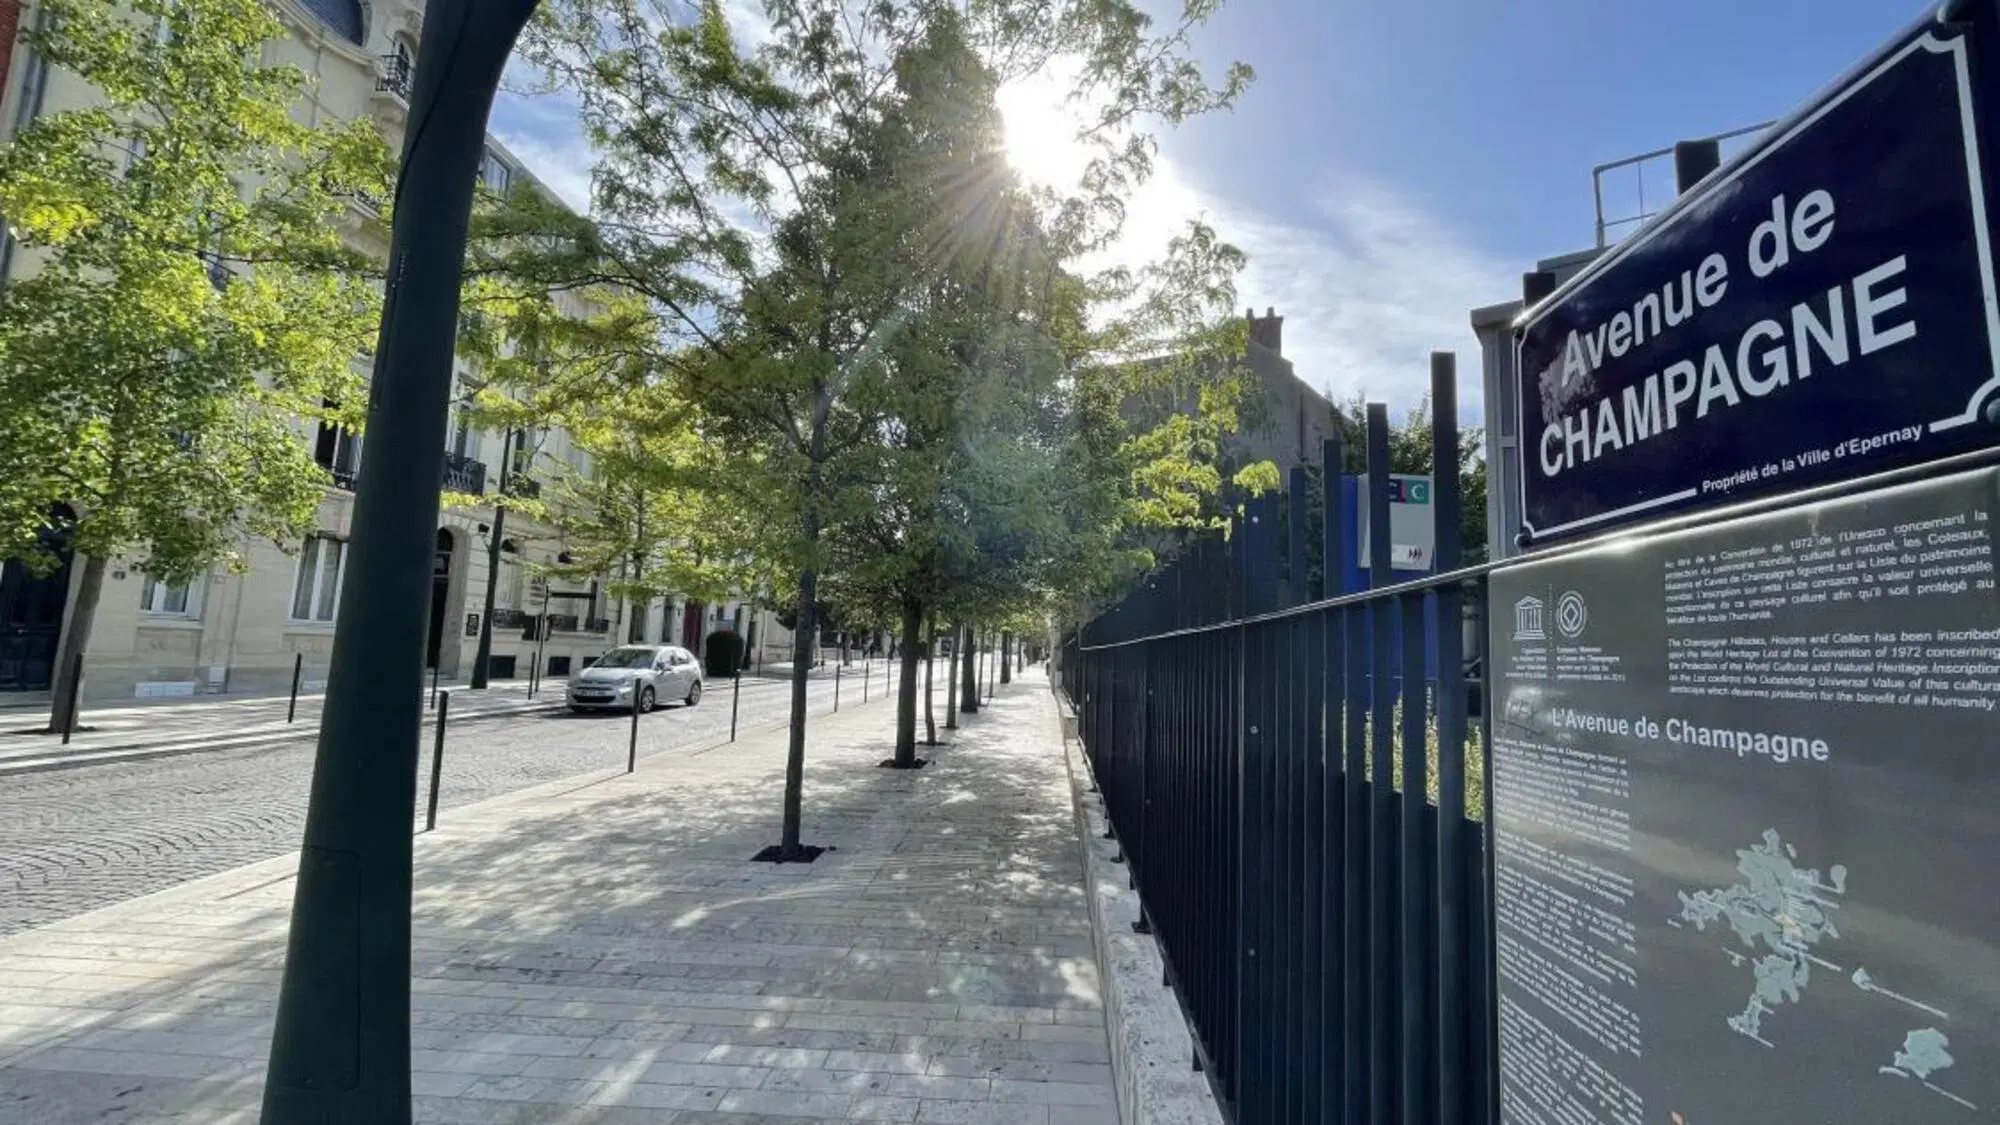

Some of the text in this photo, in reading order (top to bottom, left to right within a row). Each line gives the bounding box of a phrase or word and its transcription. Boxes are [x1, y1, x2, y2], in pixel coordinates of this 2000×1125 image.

[1562, 188, 1836, 387] Avenue de
[1540, 254, 1917, 477] CHAMPAGNE
[1702, 424, 1922, 493] Propriété de la Ville d'Epernay
[1894, 513, 1965, 534] concernant
[1974, 509, 1988, 521] la
[1903, 537, 1922, 548] les
[1869, 556, 1897, 567] Liste
[1899, 553, 1917, 564] du
[1920, 544, 1992, 564] patrimoine
[1878, 570, 1914, 581] valeur
[1920, 560, 1993, 577] universelle
[1917, 579, 1967, 596] protégé
[1976, 578, 1995, 589] au
[1874, 631, 1897, 643] has
[1901, 630, 1932, 642] been
[1875, 646, 1887, 658] of
[1891, 646, 1921, 658] 1972
[1926, 645, 2000, 660] concerning
[1872, 677, 1905, 689] Value
[1908, 677, 1922, 689] of
[1925, 678, 1949, 690] this
[1953, 679, 2000, 692] cultura
[1836, 691, 1853, 702] the
[1856, 691, 1895, 704] benefit
[1897, 692, 1911, 705] of
[1913, 694, 1928, 706] all
[1551, 707, 1830, 763] L'Avenue de Champagne
